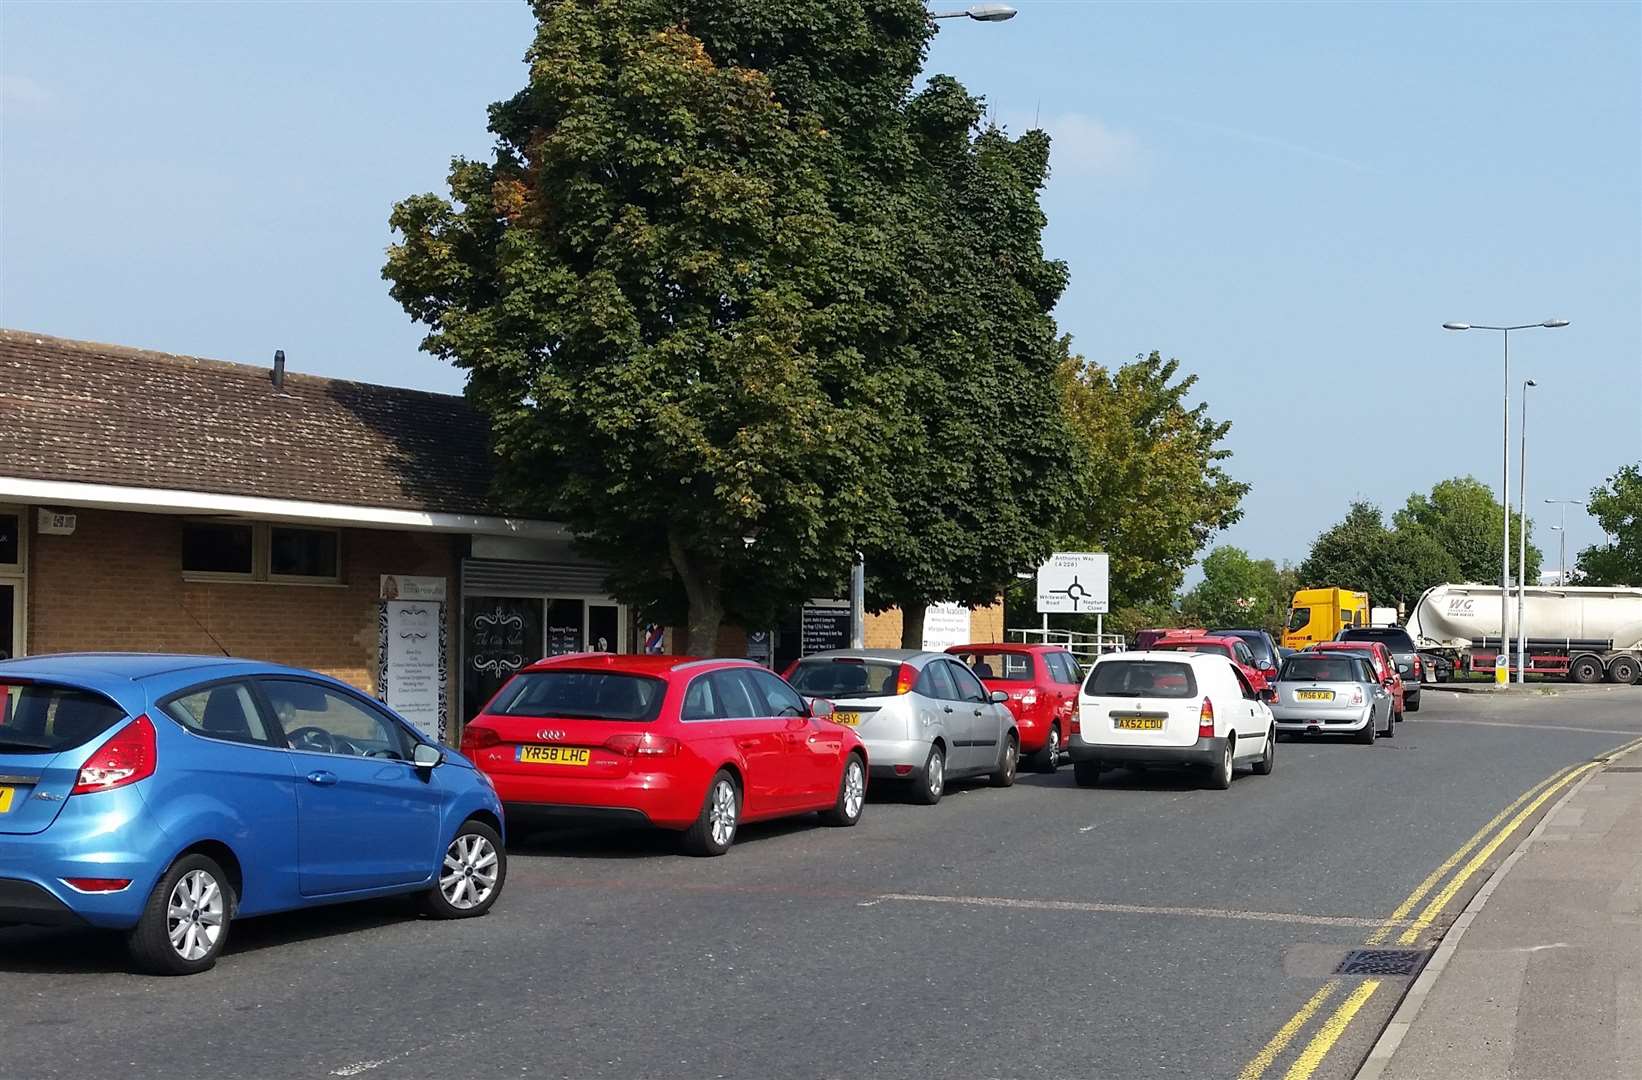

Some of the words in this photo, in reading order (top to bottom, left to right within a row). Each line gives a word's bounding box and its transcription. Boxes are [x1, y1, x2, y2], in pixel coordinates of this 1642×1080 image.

[837, 713, 858, 724] SBY
[1120, 719, 1142, 729] AX52
[525, 746, 559, 761] YR58
[561, 749, 588, 762] LHC
